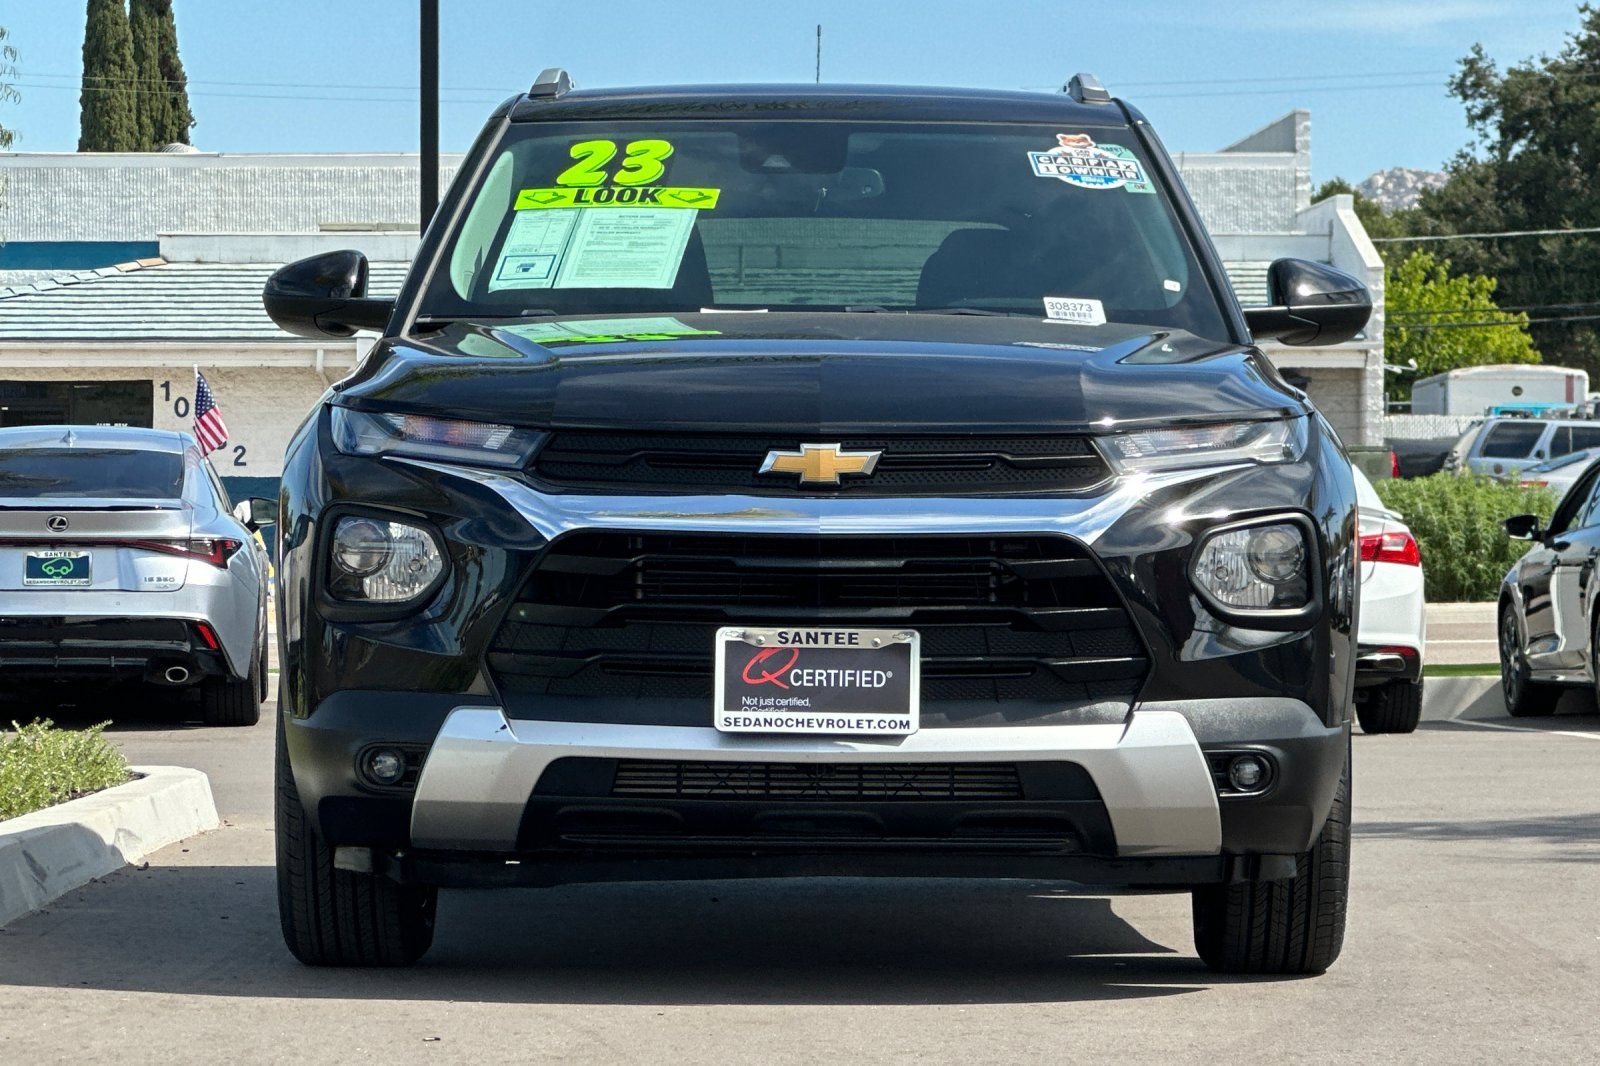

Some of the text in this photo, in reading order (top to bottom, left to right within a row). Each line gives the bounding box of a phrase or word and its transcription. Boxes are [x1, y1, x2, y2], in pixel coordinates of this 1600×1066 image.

[556, 139, 674, 187] 23
[1038, 155, 1133, 170] CARFAX
[1058, 166, 1138, 179] OWNER
[573, 188, 666, 205] LOOK
[1047, 301, 1093, 312] 308373
[777, 631, 859, 646] SANTEE
[742, 647, 800, 689] Q
[742, 696, 811, 707] Not just certified,
[723, 716, 911, 730] SEDANOCHEVROLET.COM
